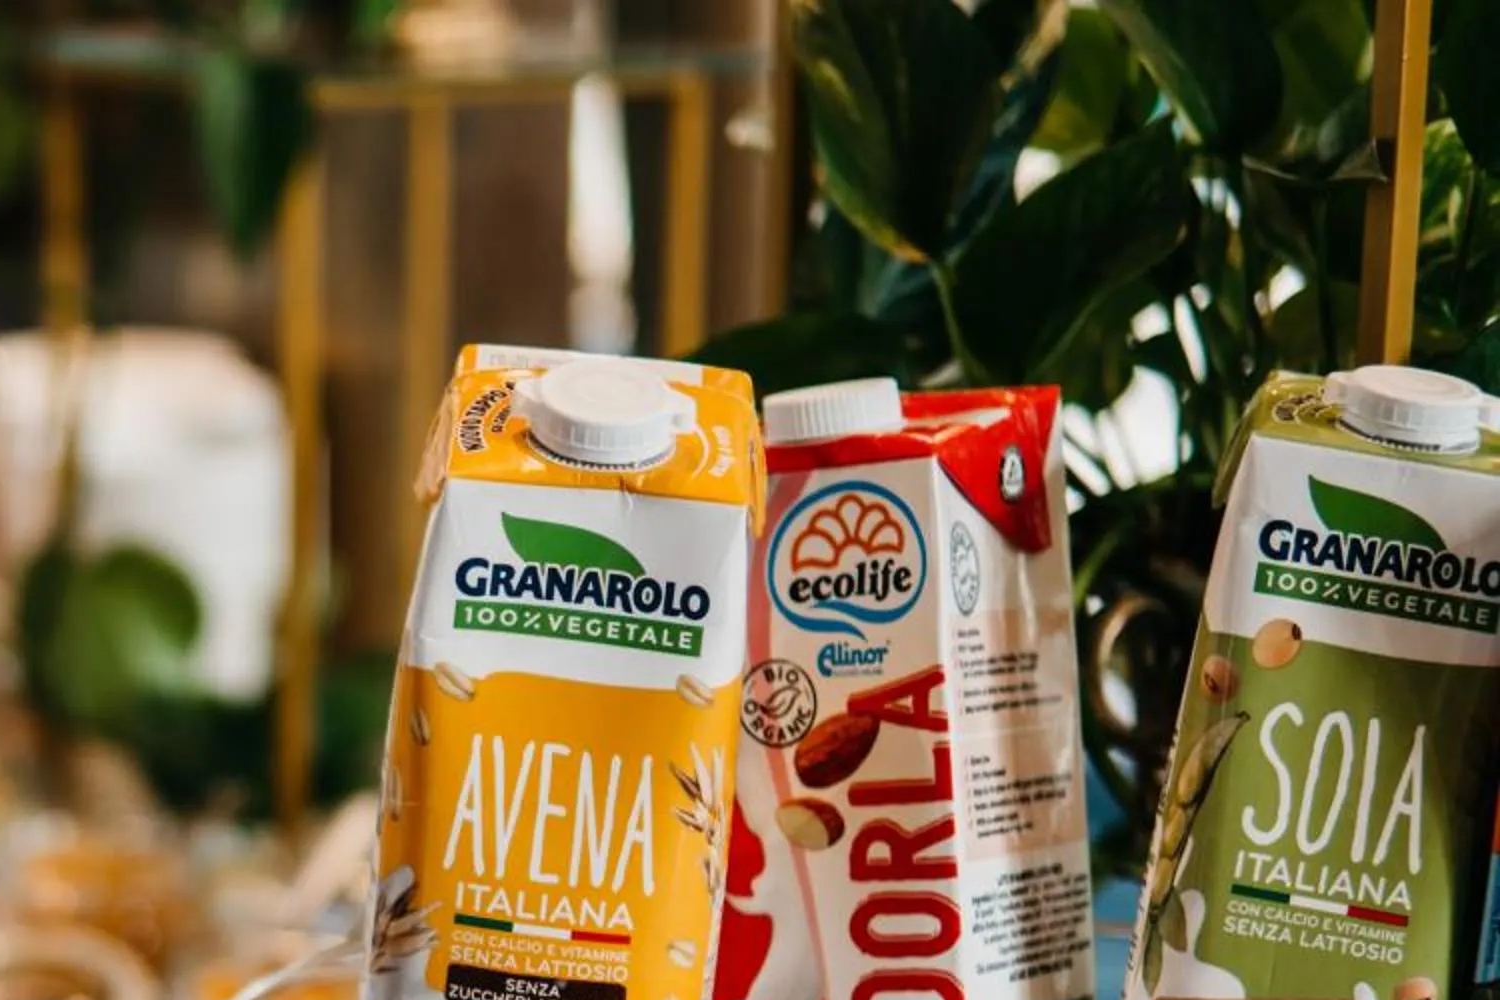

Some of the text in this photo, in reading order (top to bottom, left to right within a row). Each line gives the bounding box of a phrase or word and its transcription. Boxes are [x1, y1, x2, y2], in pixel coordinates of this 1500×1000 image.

[789, 558, 912, 603] ecolife
[1259, 520, 1500, 596] GRANAROLO
[455, 557, 710, 621] GRANAROLO
[1265, 570, 1490, 624] 100% VEGETALE
[464, 605, 694, 650] 100% VEGETALE
[763, 666, 799, 684] BIO
[817, 640, 888, 677] Alinor
[1242, 702, 1426, 875] SOIA
[443, 733, 655, 897] AVENA
[1233, 849, 1412, 911] ITALIANA
[454, 881, 634, 930] ITALIANA
[1227, 900, 1407, 945] CON CALCIO E VITAMINE
[451, 945, 629, 982] SENZA LATTOSIO
[452, 930, 630, 964] CON CALCIO E VITAMINE
[1223, 915, 1404, 965] SENZA LATTOSIO
[506, 978, 561, 999] SENZA
